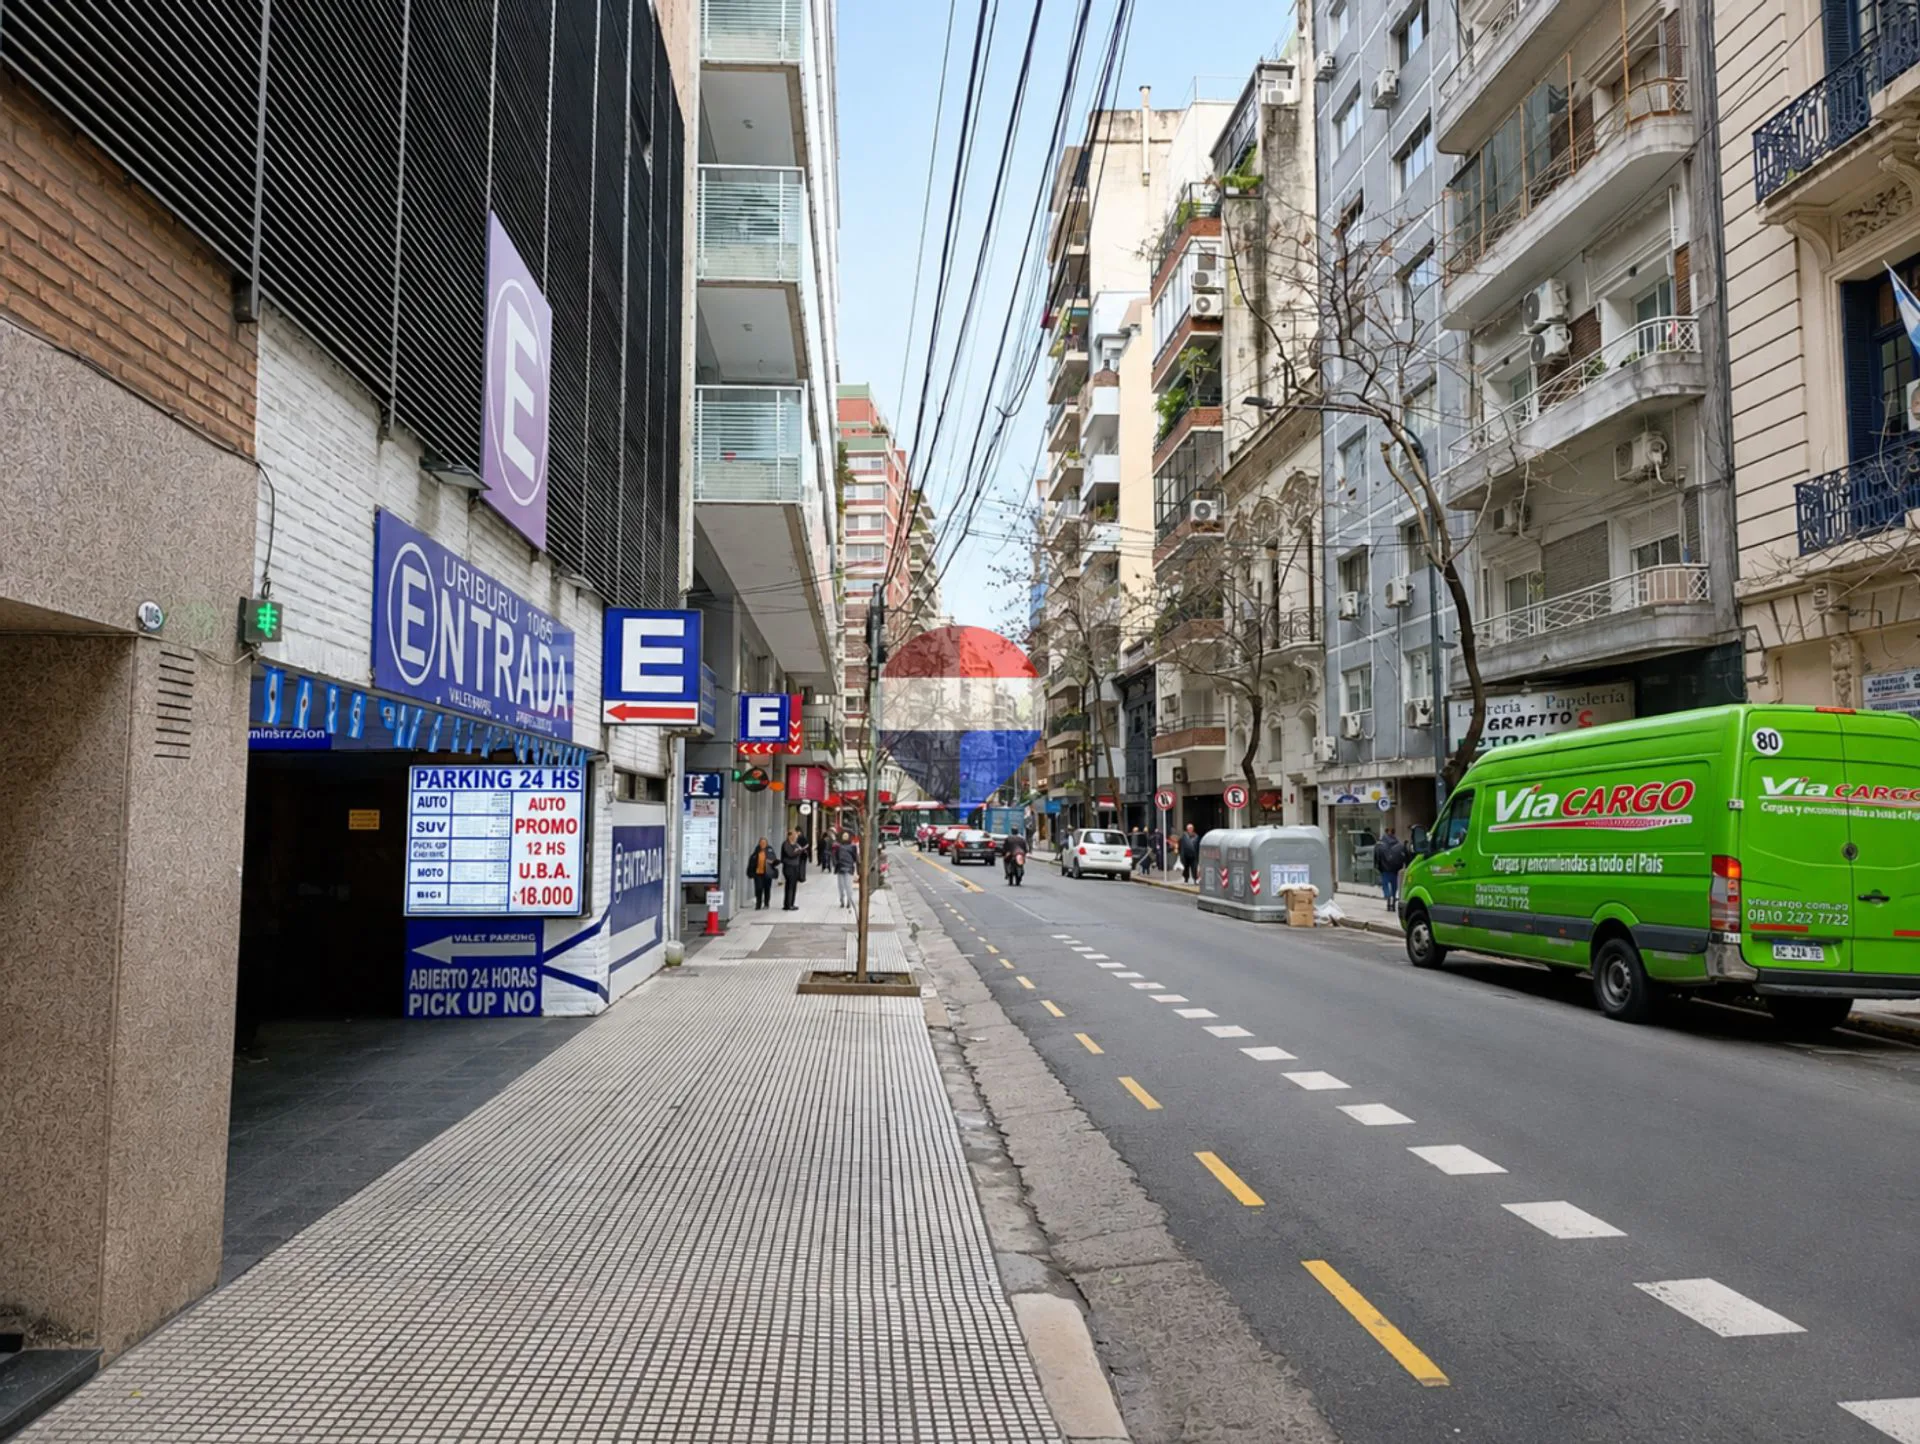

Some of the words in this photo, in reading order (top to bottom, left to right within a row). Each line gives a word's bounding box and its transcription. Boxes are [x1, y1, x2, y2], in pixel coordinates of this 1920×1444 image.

[503, 300, 537, 484] E
[443, 556, 518, 624] URIBURU
[401, 563, 569, 722] ENTRADA
[621, 618, 684, 693] E
[748, 698, 779, 737] E
[1488, 711, 1572, 731] GRAFITO
[1756, 731, 1779, 751] 80
[416, 770, 512, 788] PARKING
[519, 770, 543, 788] 24
[552, 770, 580, 788] HS
[417, 796, 447, 808] AUTO
[528, 797, 566, 811] AUTO
[1560, 779, 1696, 817] CARGO
[416, 822, 446, 833] SUV
[515, 818, 578, 834] PROMO
[527, 842, 541, 855] 12
[546, 842, 565, 855] HS
[417, 868, 444, 877] MOTO
[519, 863, 570, 879] U.B.A.
[1520, 860, 1526, 874] y
[1590, 858, 1597, 873] a
[1599, 854, 1624, 873] todo
[1625, 854, 1637, 873] el
[1817, 912, 1849, 926] 7722
[454, 934, 486, 942] VALET
[490, 933, 536, 941] PARKING
[409, 969, 468, 990] ABIERTO
[472, 968, 488, 989] 24
[492, 967, 537, 988] HORAS
[409, 992, 461, 1015] PICK
[468, 992, 497, 1015] UP
[503, 991, 535, 1013] NO
